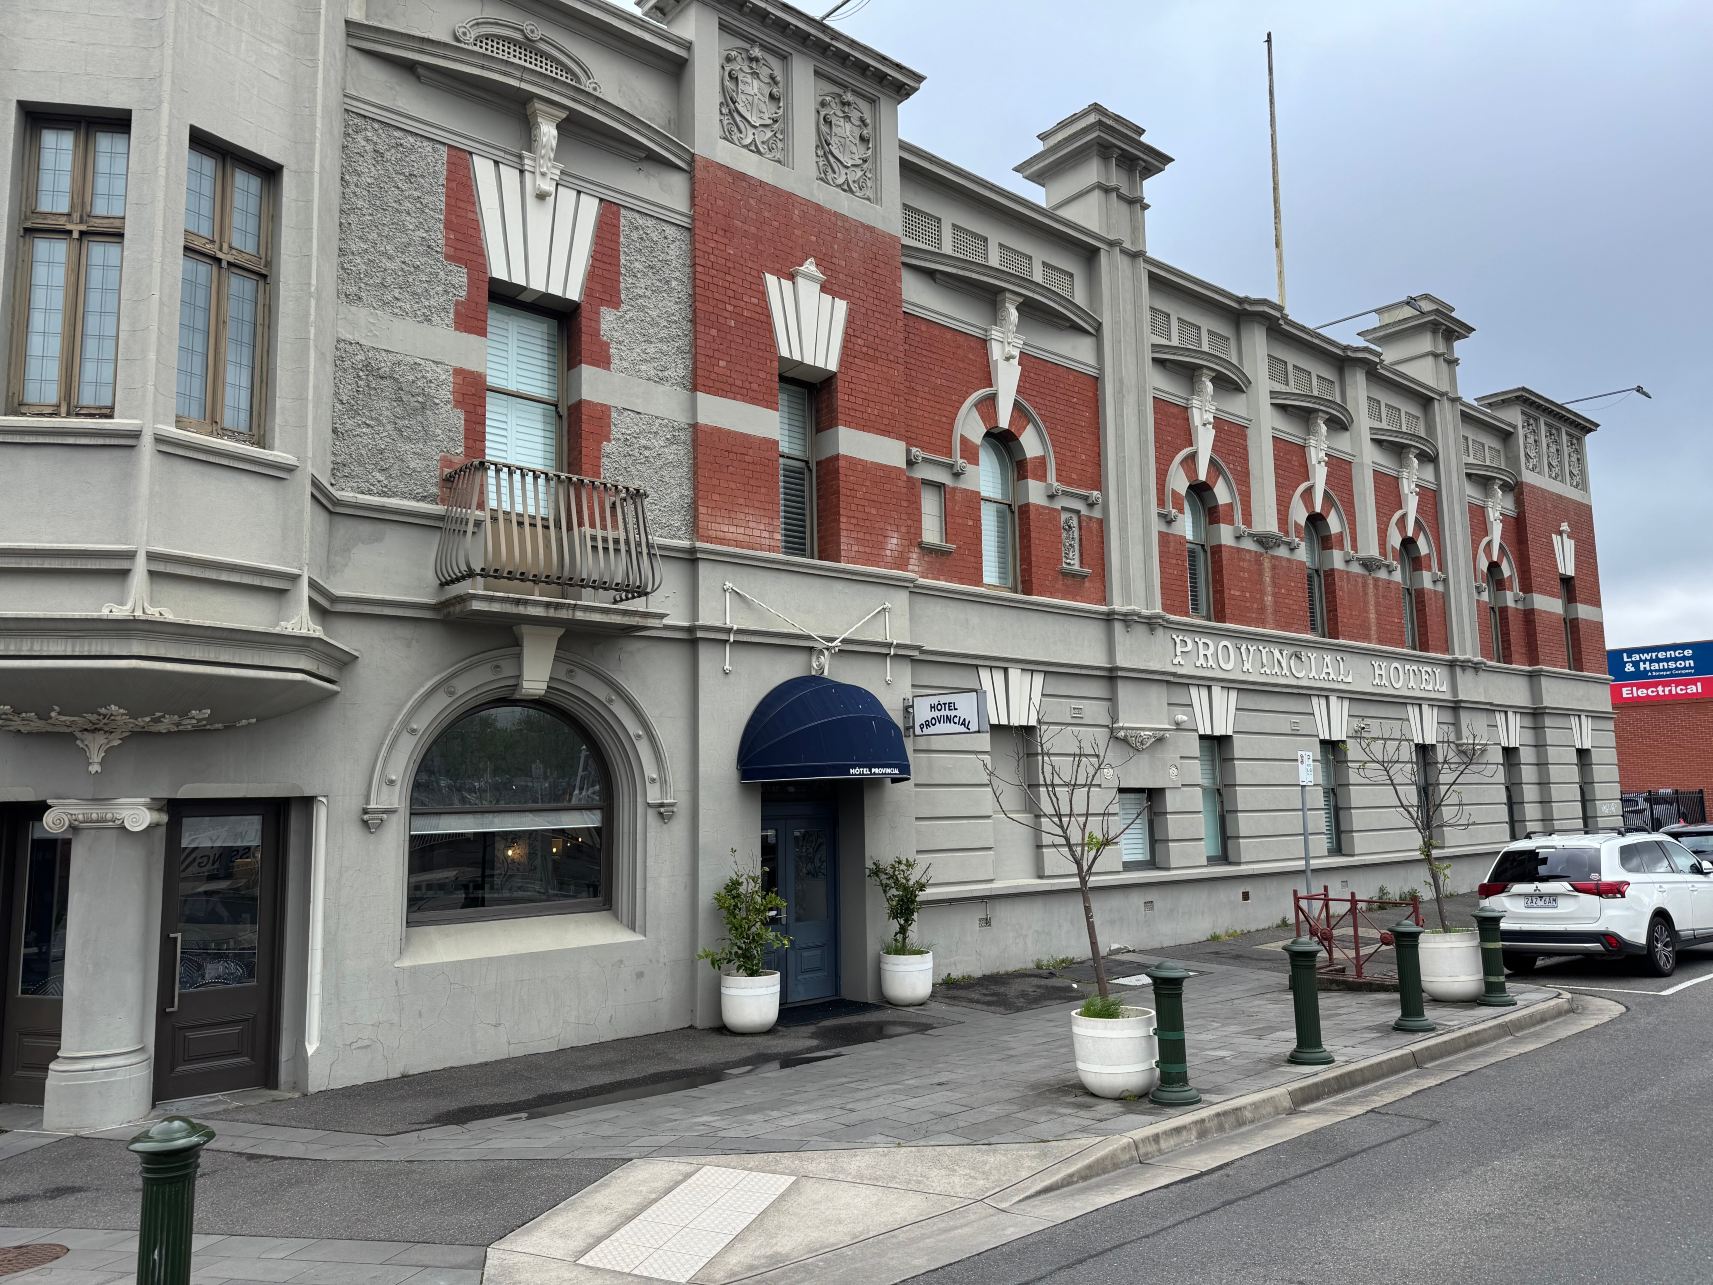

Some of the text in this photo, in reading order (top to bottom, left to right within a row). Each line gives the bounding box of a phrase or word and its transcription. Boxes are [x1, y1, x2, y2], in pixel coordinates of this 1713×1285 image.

[1171, 633, 1447, 692] PROVINCIAL HOTEL
[1623, 649, 1693, 662] Lawrence
[1624, 660, 1695, 672] & Hanson
[1622, 682, 1702, 698] Electrical
[919, 714, 971, 733] PROVINCIAL
